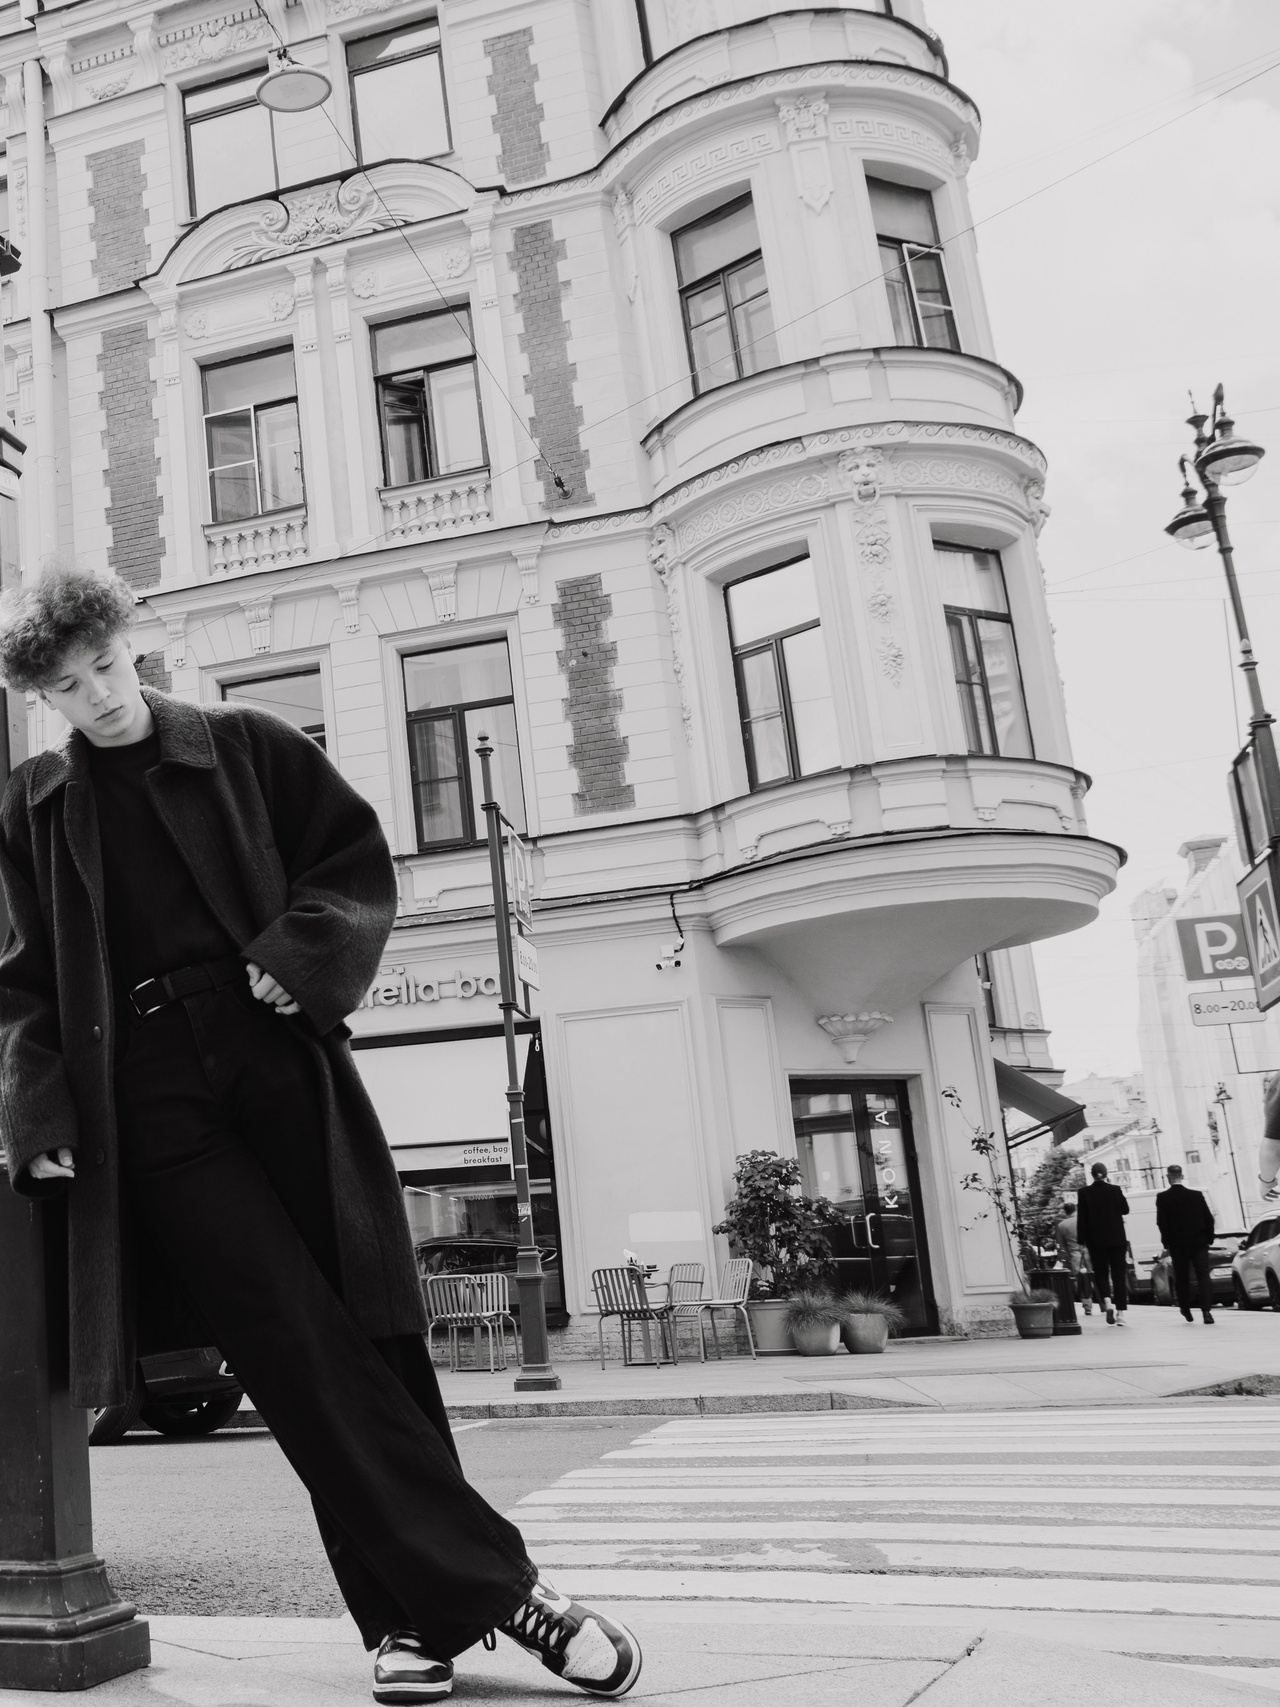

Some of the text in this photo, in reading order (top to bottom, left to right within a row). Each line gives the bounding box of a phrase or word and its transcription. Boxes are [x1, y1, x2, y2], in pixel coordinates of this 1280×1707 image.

[1194, 921, 1237, 974] P
[358, 969, 501, 1008] rella ba
[463, 1145, 510, 1155] coffee, bag
[463, 1156, 503, 1164] breakfast
[875, 1110, 899, 1209] KONA
